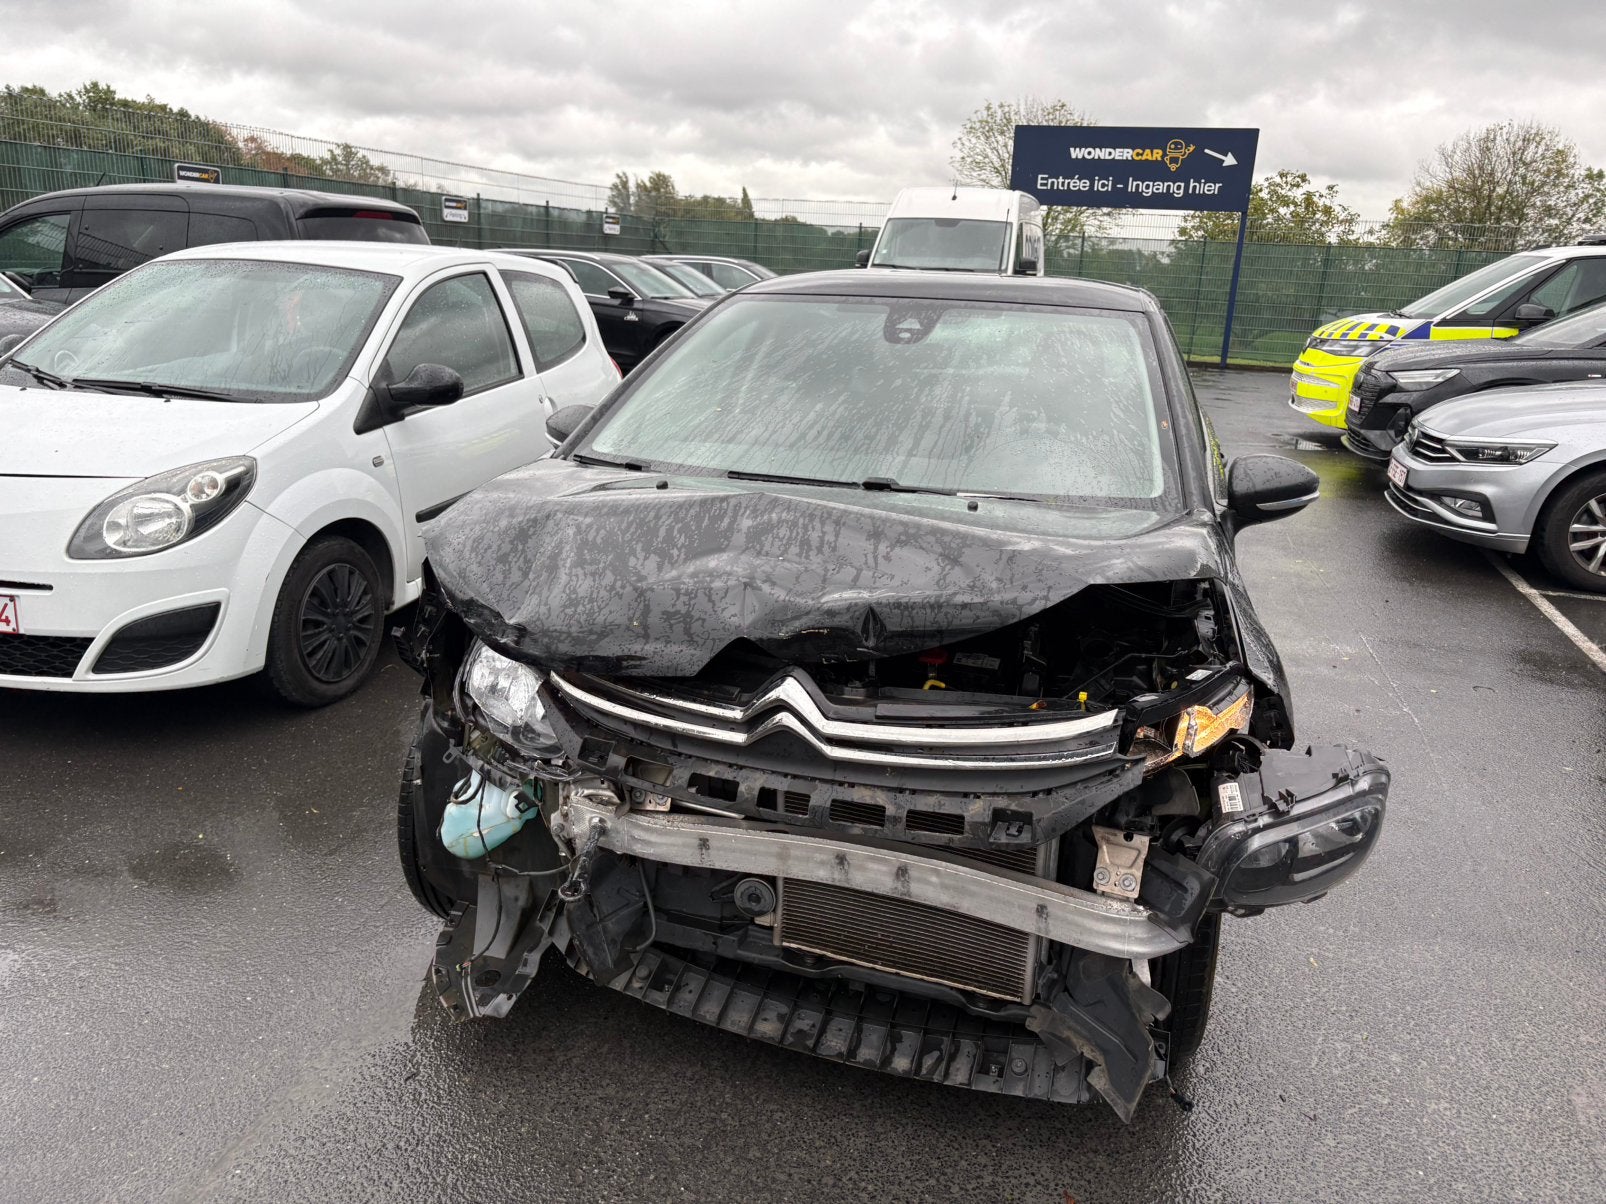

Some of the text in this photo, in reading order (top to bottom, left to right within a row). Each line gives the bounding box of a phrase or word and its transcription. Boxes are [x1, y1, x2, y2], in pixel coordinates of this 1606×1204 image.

[1069, 147, 1163, 161] WONDERCAR
[1036, 174, 1090, 191] Entrée
[1093, 176, 1113, 192] ici
[1127, 176, 1185, 198] Ingang
[1188, 178, 1223, 195] hier
